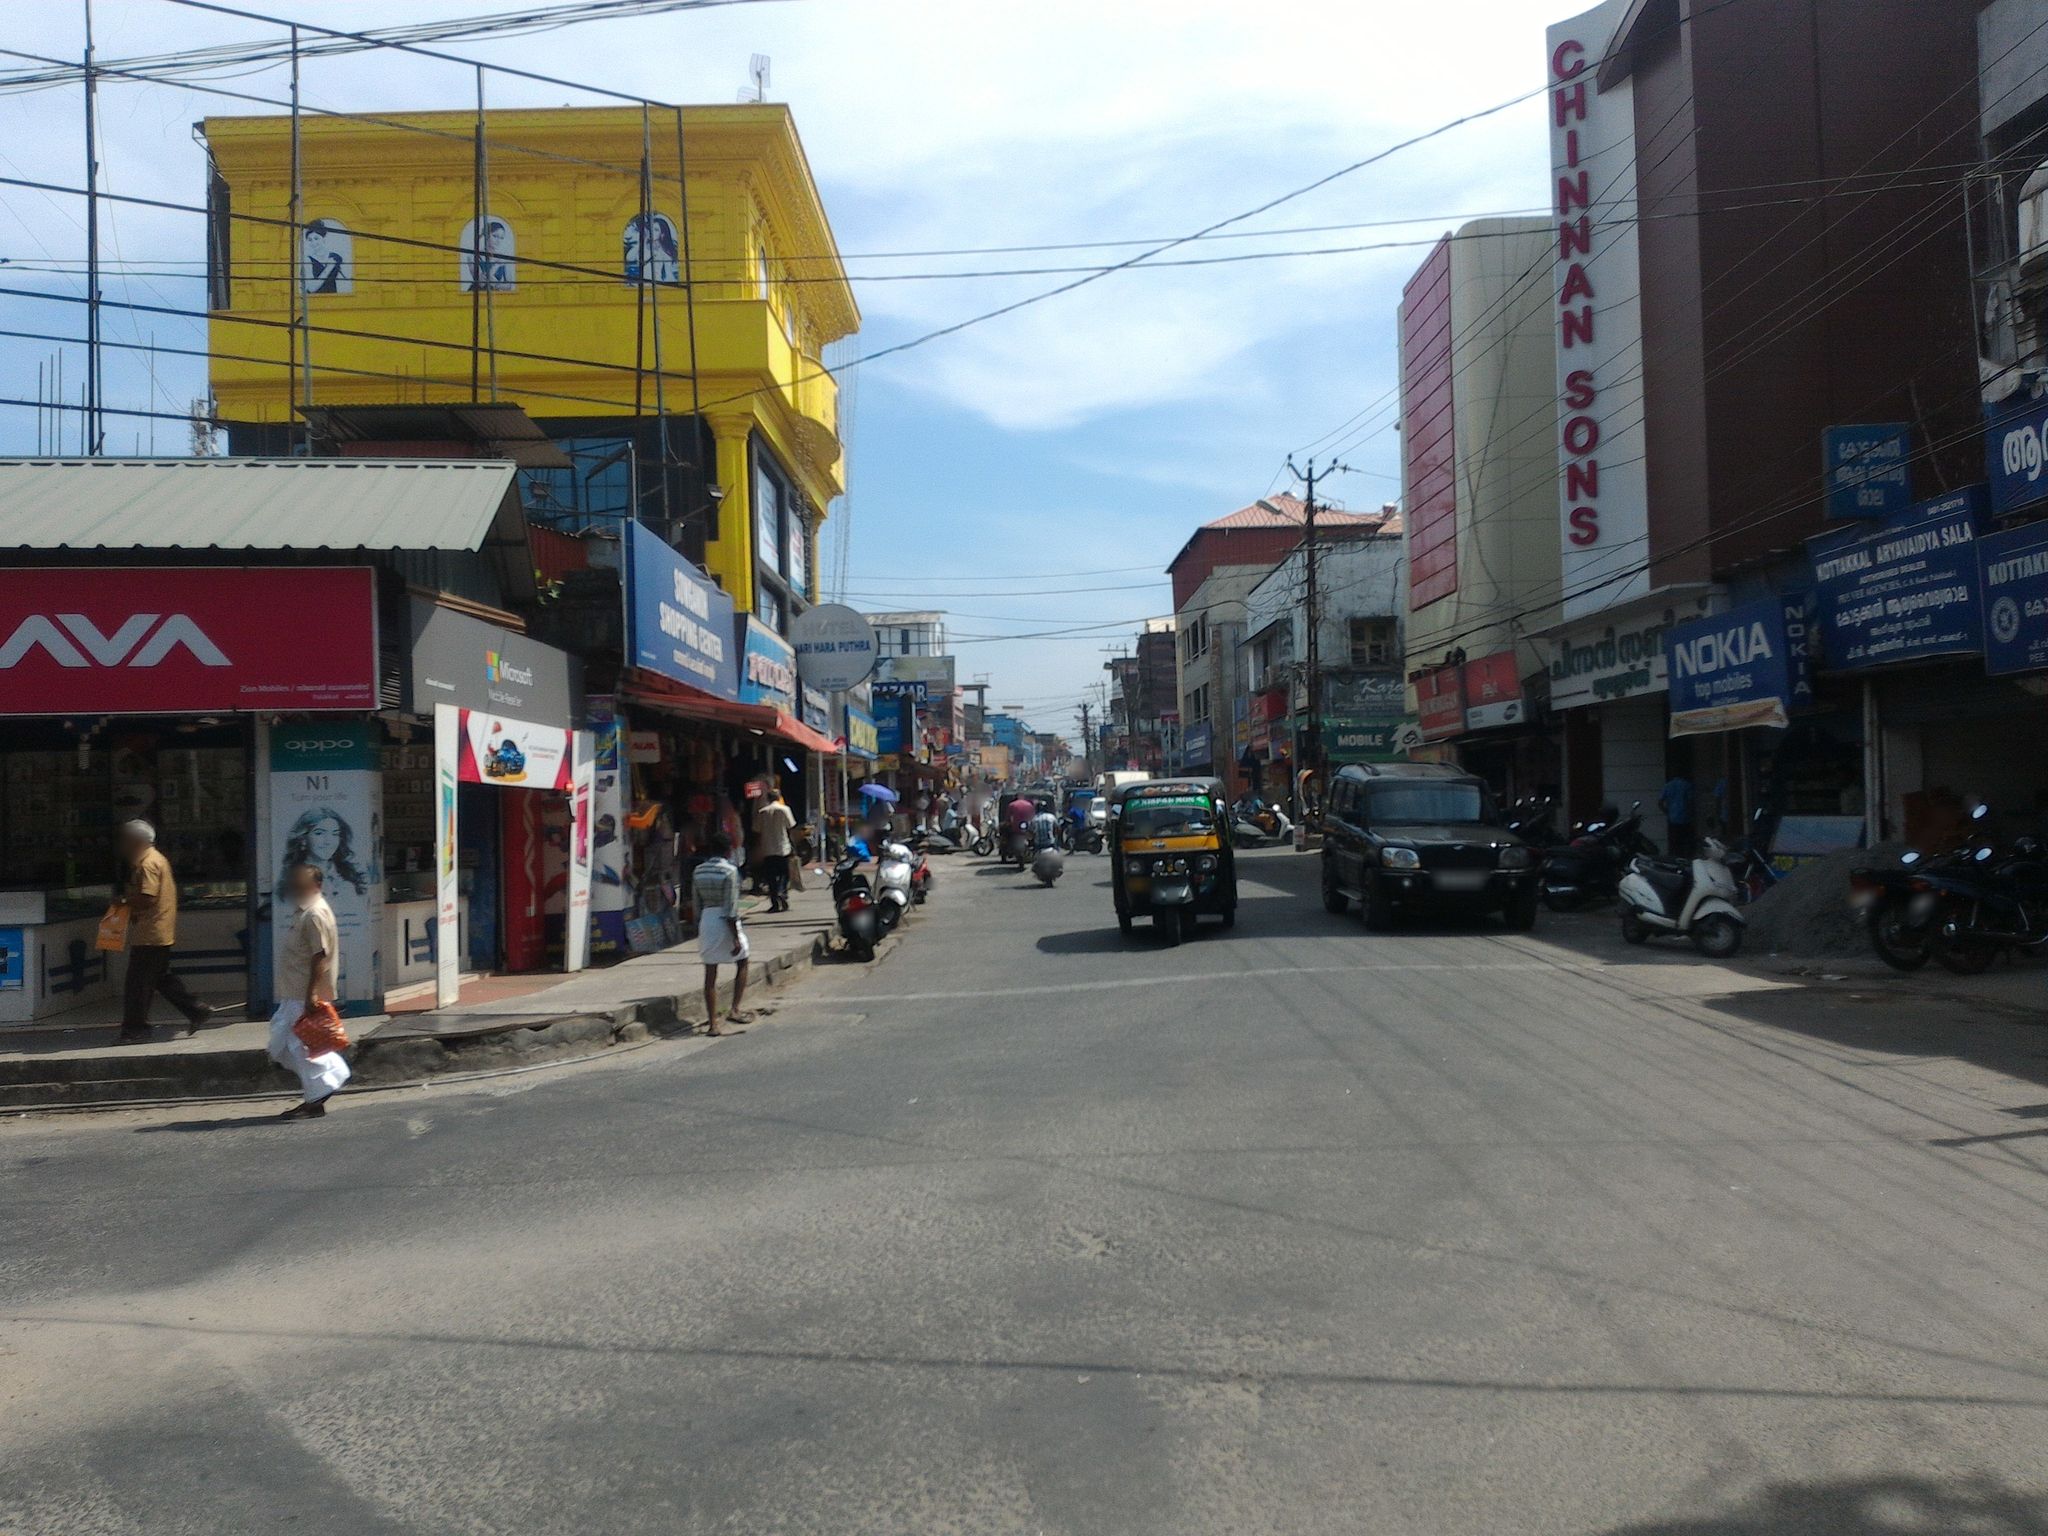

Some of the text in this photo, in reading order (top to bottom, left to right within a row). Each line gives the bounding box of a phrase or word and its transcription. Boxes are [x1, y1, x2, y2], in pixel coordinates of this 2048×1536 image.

[1552, 39, 1600, 546] CHINNAN SONS
[1942, 521, 1974, 547] SALA
[1988, 551, 2048, 586] KOTTAK
[1674, 621, 1773, 679] NOKIA
[1784, 606, 1811, 694] NOKIA
[499, 660, 533, 687] Microsoft
[1337, 733, 1384, 747] MOBILE
[306, 775, 329, 791] N1
